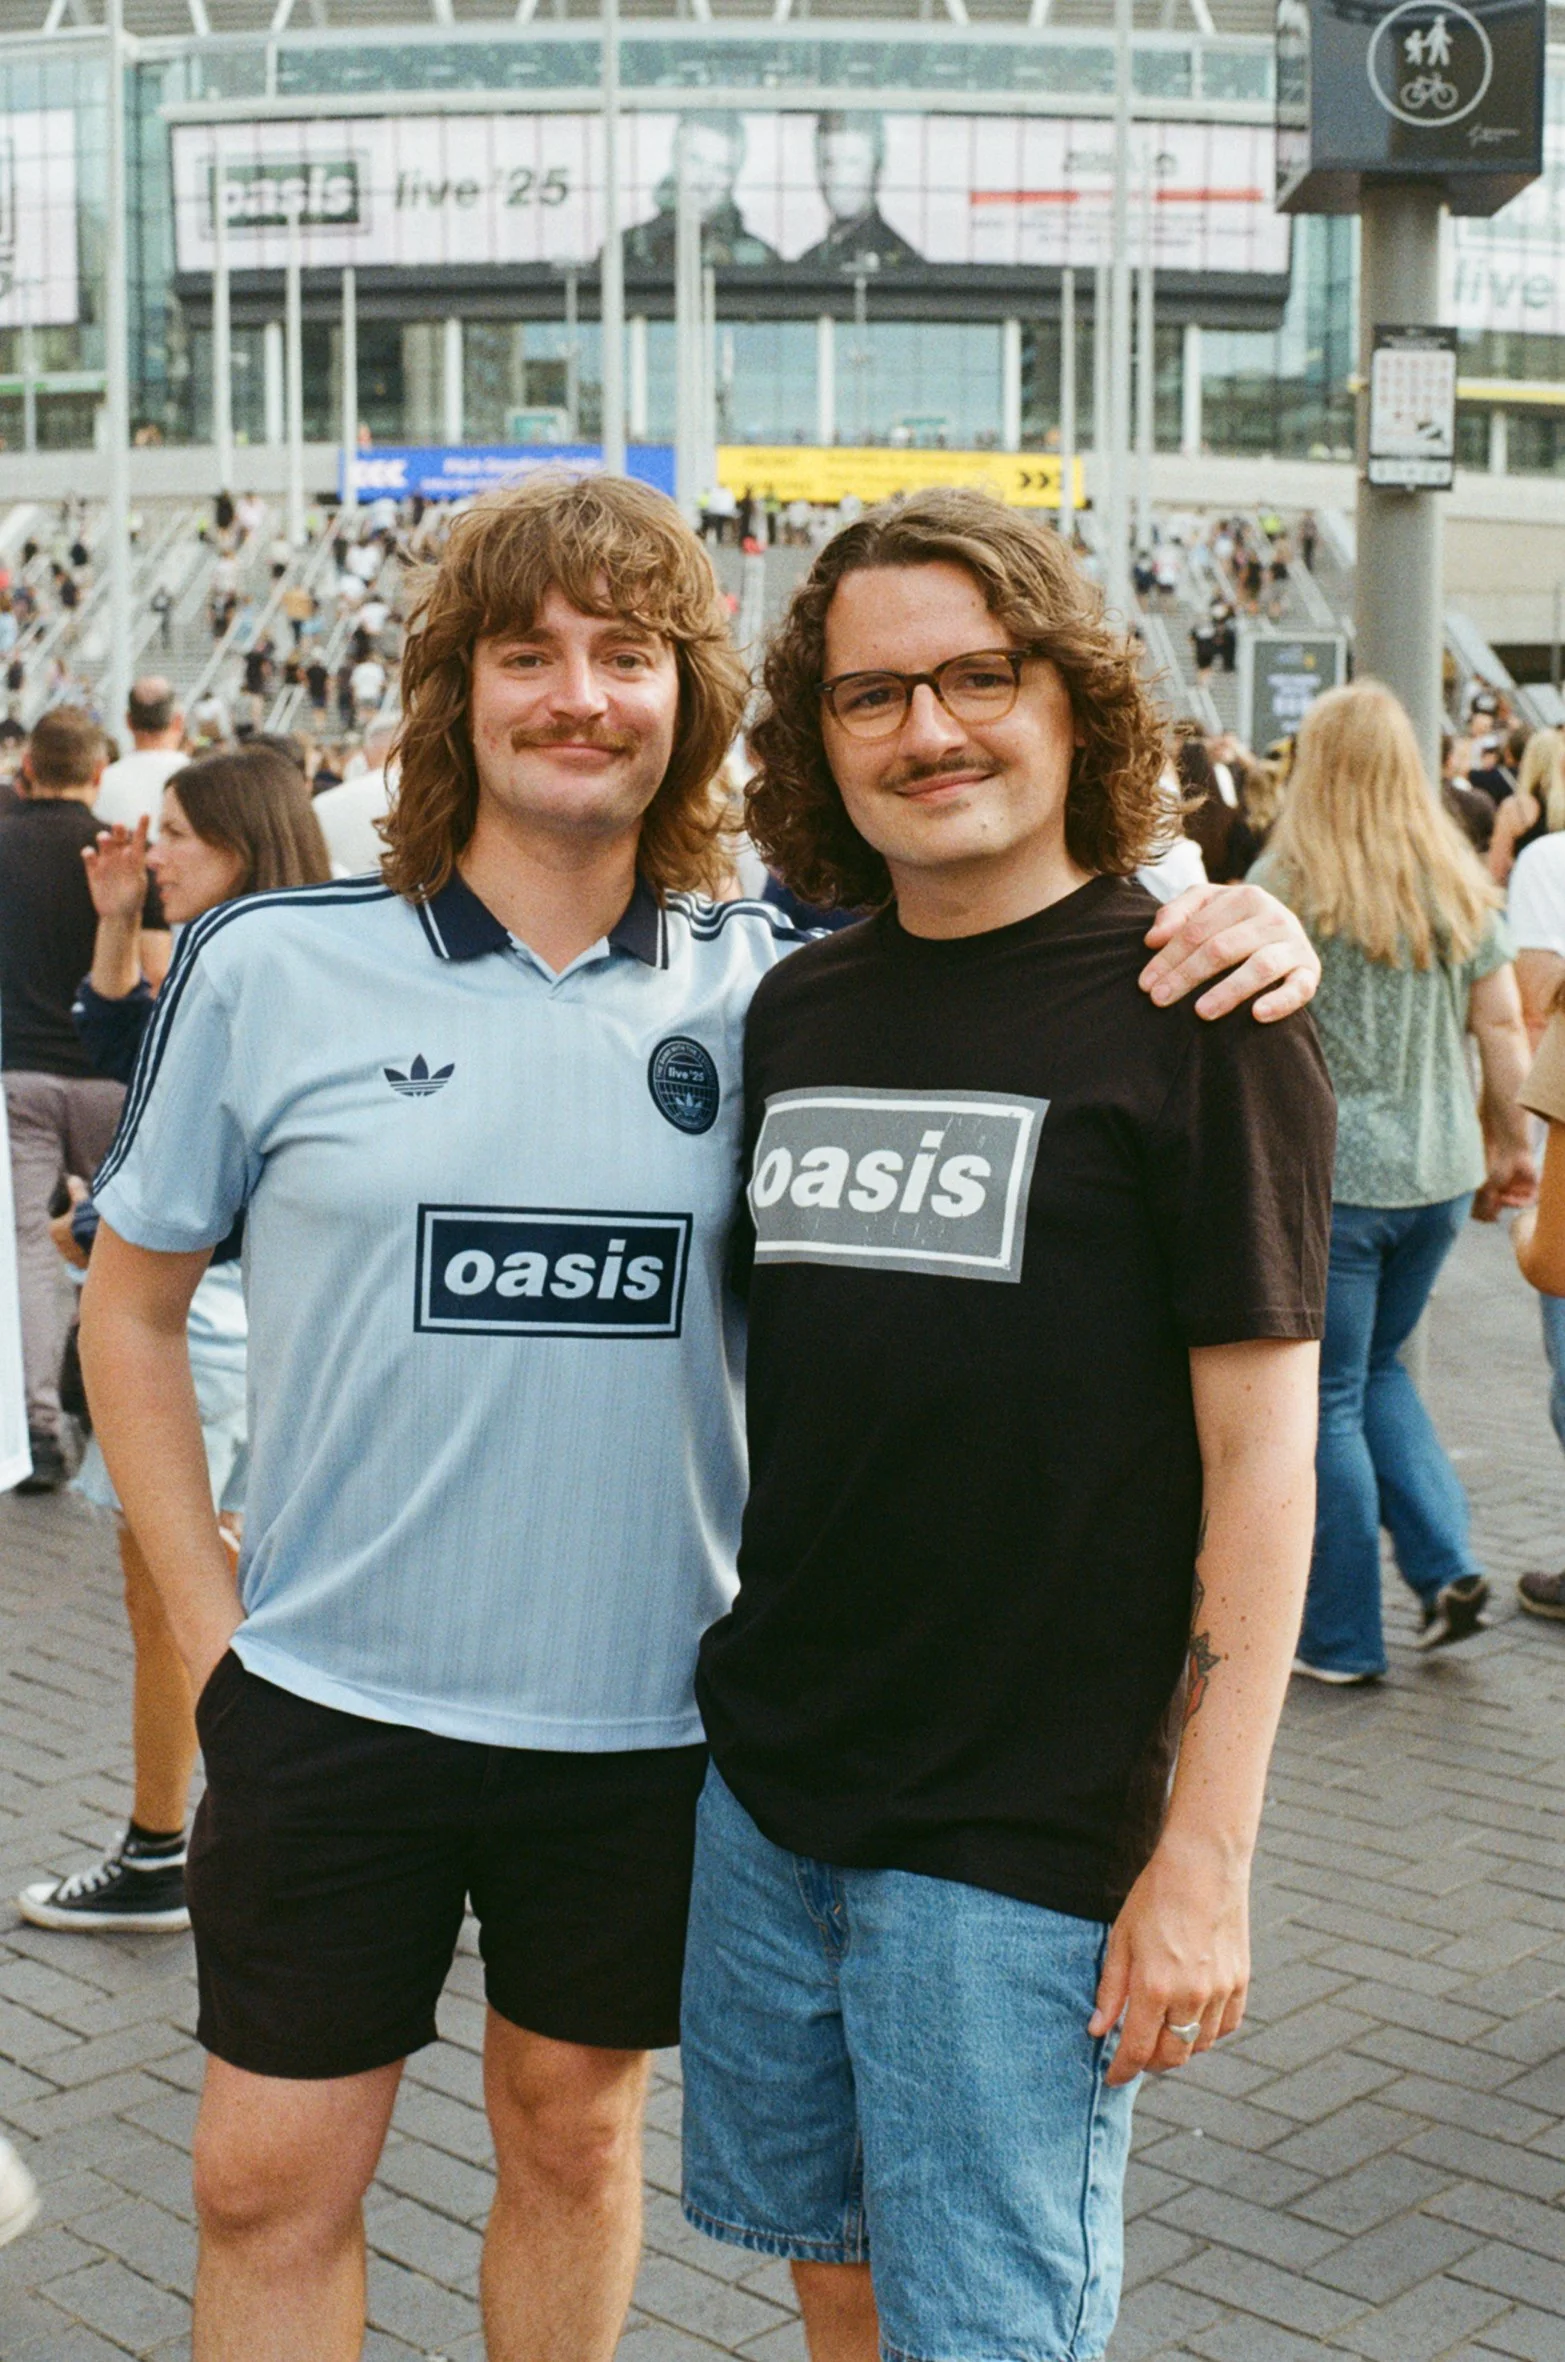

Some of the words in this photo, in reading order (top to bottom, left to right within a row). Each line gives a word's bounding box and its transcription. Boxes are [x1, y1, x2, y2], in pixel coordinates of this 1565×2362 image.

[397, 167, 480, 212] live
[1453, 257, 1553, 308] live
[668, 1065, 689, 1080] live
[753, 1130, 992, 1218] oasis
[444, 1238, 664, 1301] oasis
